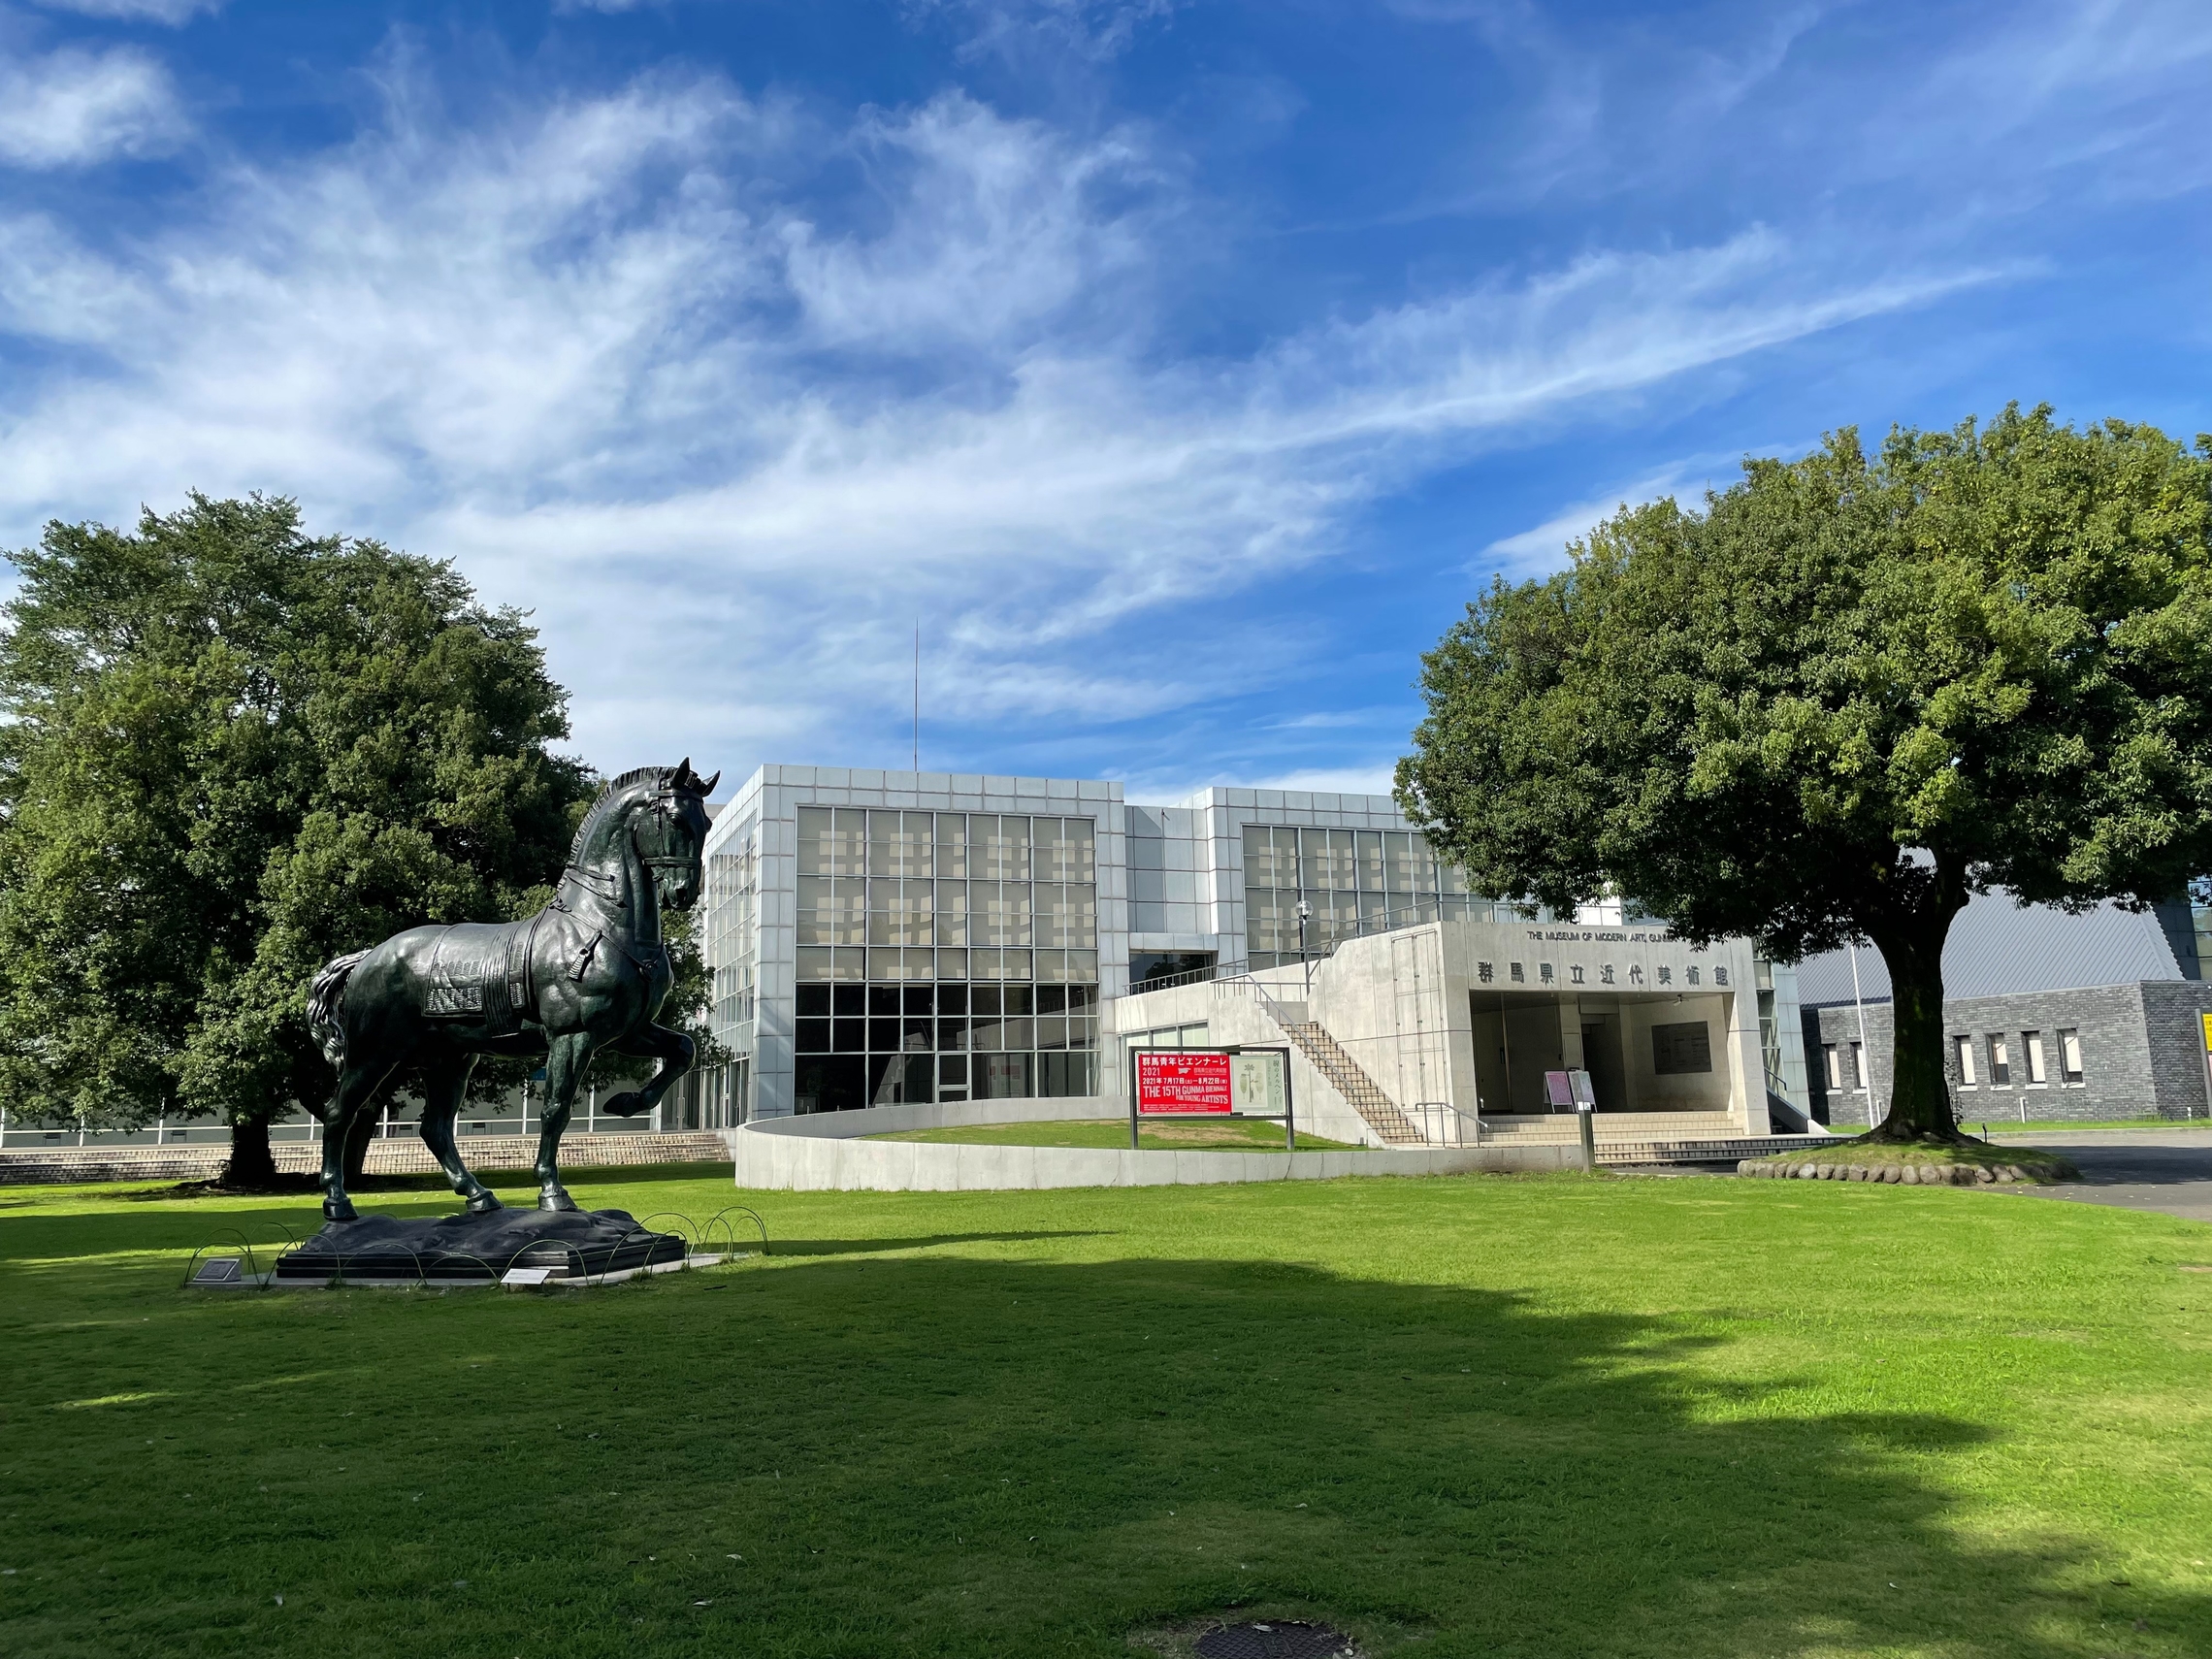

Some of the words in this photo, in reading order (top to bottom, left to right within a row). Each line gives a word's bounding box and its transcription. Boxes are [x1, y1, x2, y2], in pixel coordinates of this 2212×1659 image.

[1527, 930, 1543, 941] THE
[1545, 930, 1580, 941] MUSEUM
[1582, 931, 1593, 941] OF
[1595, 932, 1627, 942] MODERN
[1478, 961, 1729, 986] 群馬県立近代美術館
[1142, 1057, 1227, 1066] 群馬青年ビエンナーレ
[1142, 1067, 1160, 1076] 2021
[1143, 1086, 1161, 1098] THE
[1162, 1086, 1181, 1096] 15TH
[1182, 1086, 1205, 1094] GUNMA
[1201, 1094, 1228, 1104] ARTISTS
